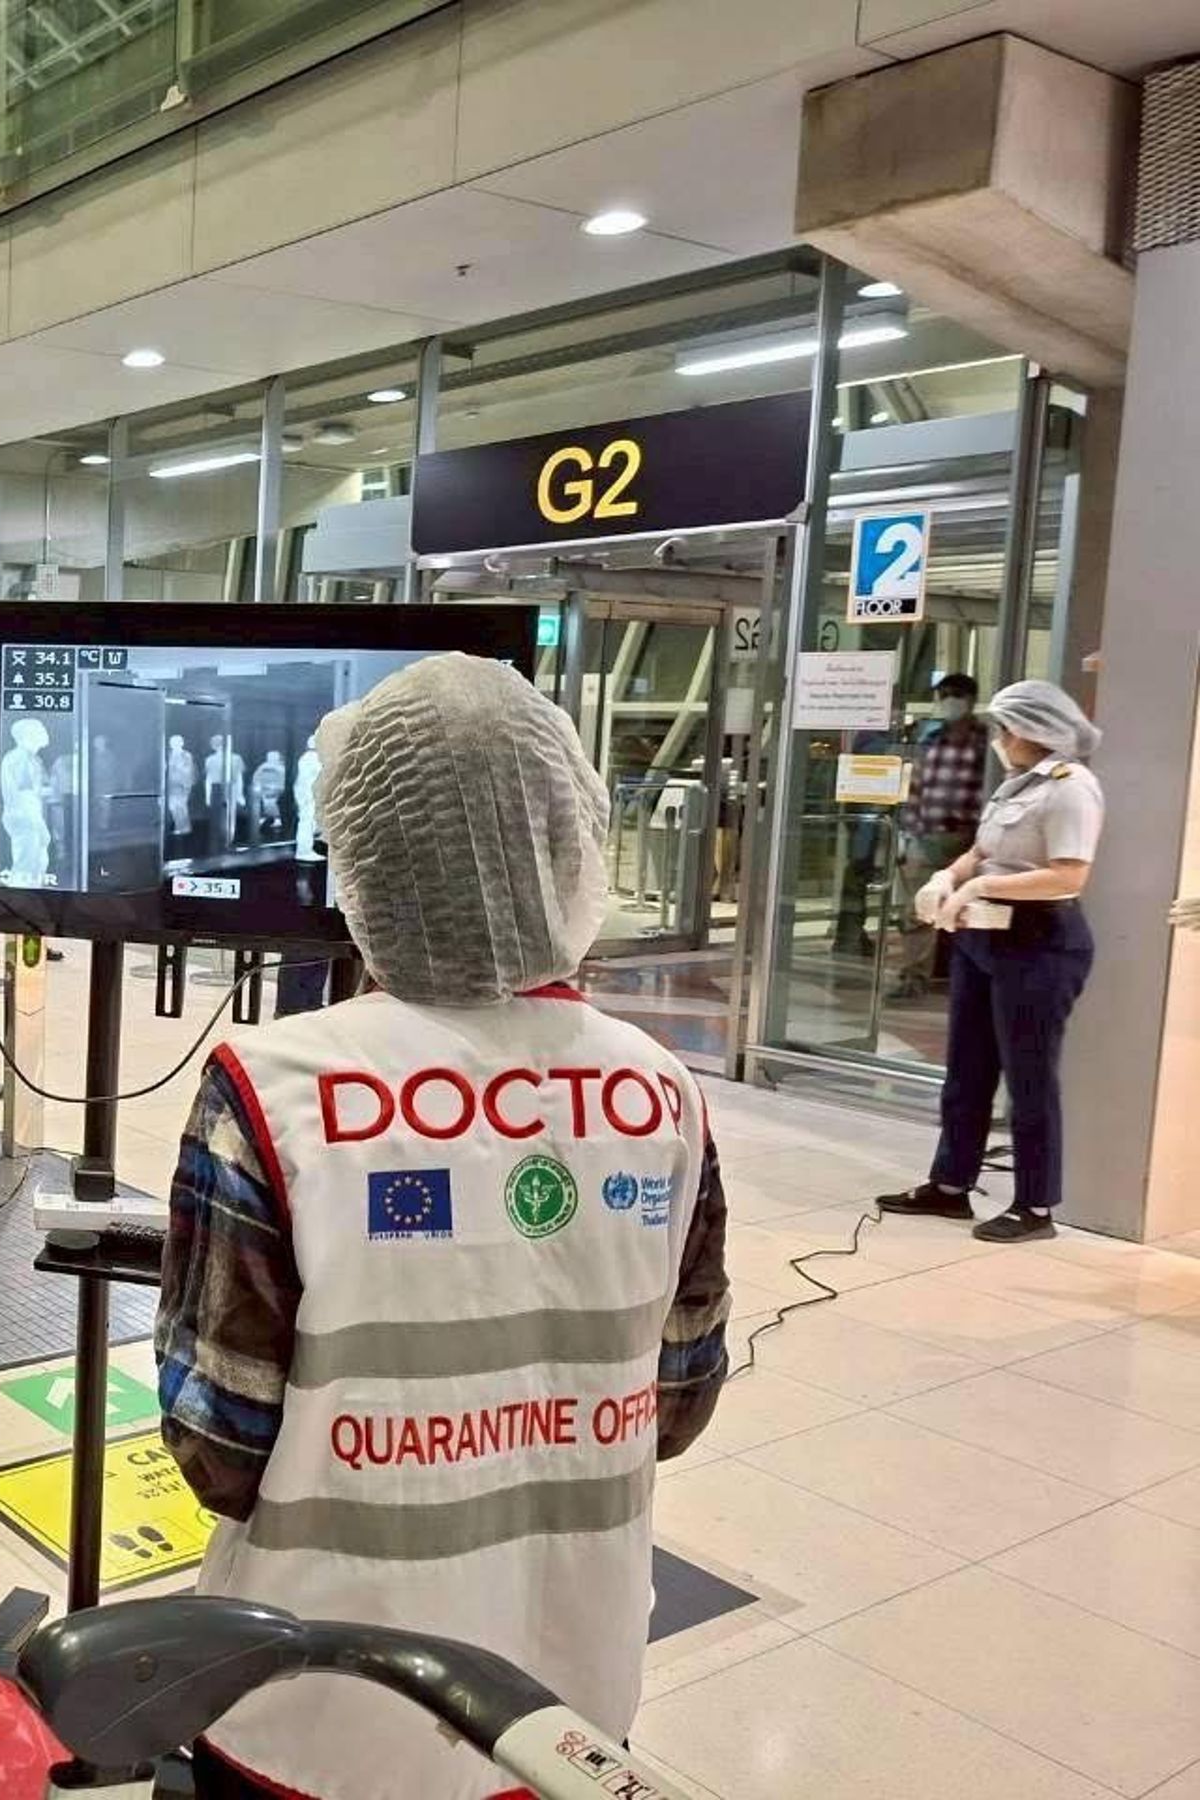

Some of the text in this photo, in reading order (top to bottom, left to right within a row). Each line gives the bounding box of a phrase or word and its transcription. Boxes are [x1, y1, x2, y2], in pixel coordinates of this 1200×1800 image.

[537, 440, 642, 524] G2
[872, 522, 922, 596] 2
[855, 600, 903, 616] FLOOR
[34, 652, 71, 666] 34.1
[34, 672, 71, 686] 35.1
[34, 694, 71, 709] 30.8
[330, 1398, 578, 1470] QUARANTINE
